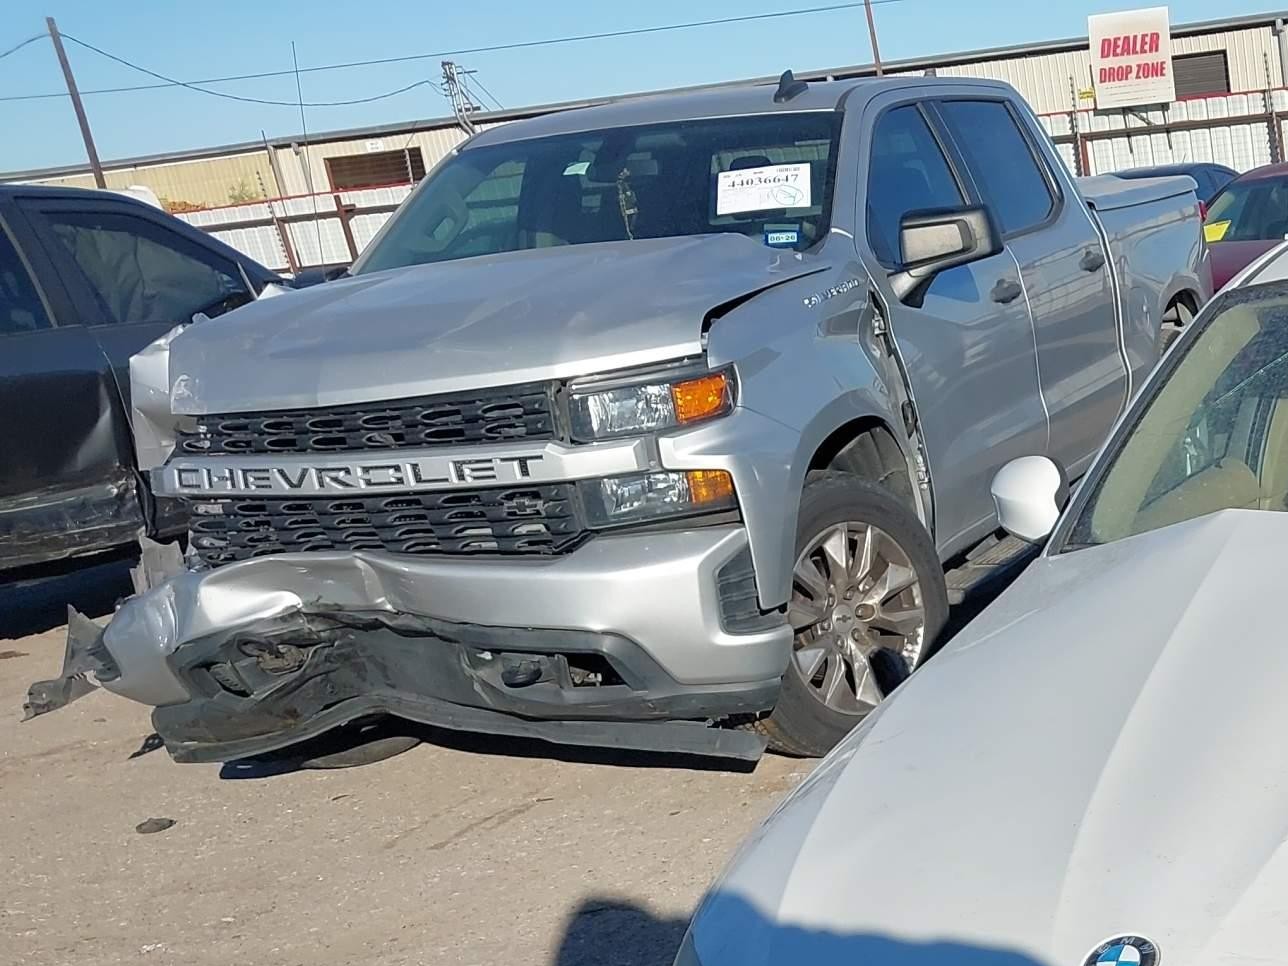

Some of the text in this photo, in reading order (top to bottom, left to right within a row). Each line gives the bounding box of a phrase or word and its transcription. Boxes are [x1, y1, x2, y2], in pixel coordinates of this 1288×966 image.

[1100, 32, 1160, 59] DEALER
[1099, 61, 1167, 84] DROP ZONE
[174, 455, 544, 491] CHEVROLET
